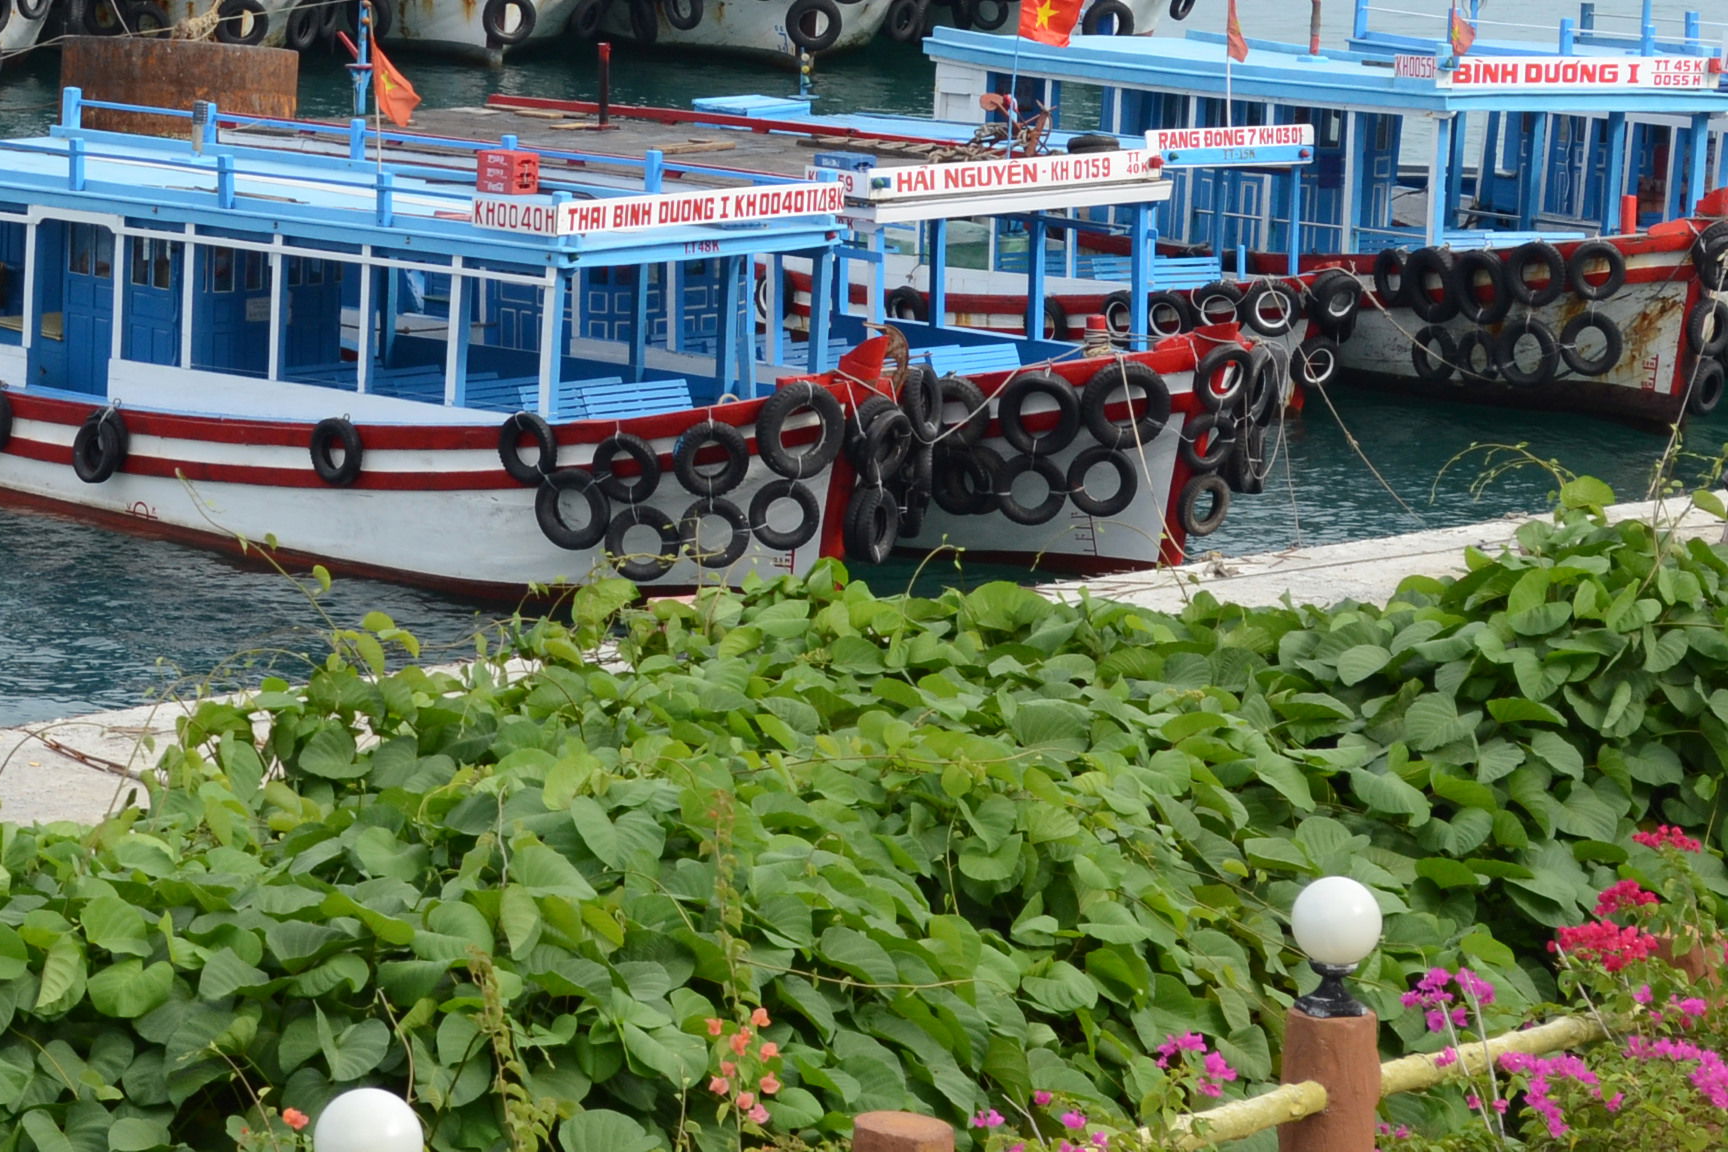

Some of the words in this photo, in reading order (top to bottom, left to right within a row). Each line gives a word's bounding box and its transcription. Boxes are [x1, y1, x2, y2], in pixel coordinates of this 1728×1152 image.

[1452, 58, 1519, 84] BÌNH
[1627, 65, 1640, 83] I
[1247, 128, 1257, 145] 7
[1127, 151, 1141, 162] TT
[944, 160, 1038, 189] NGUYÊN
[568, 206, 607, 232] THAI
[613, 202, 652, 227] BINH
[658, 199, 715, 224] DUONG
